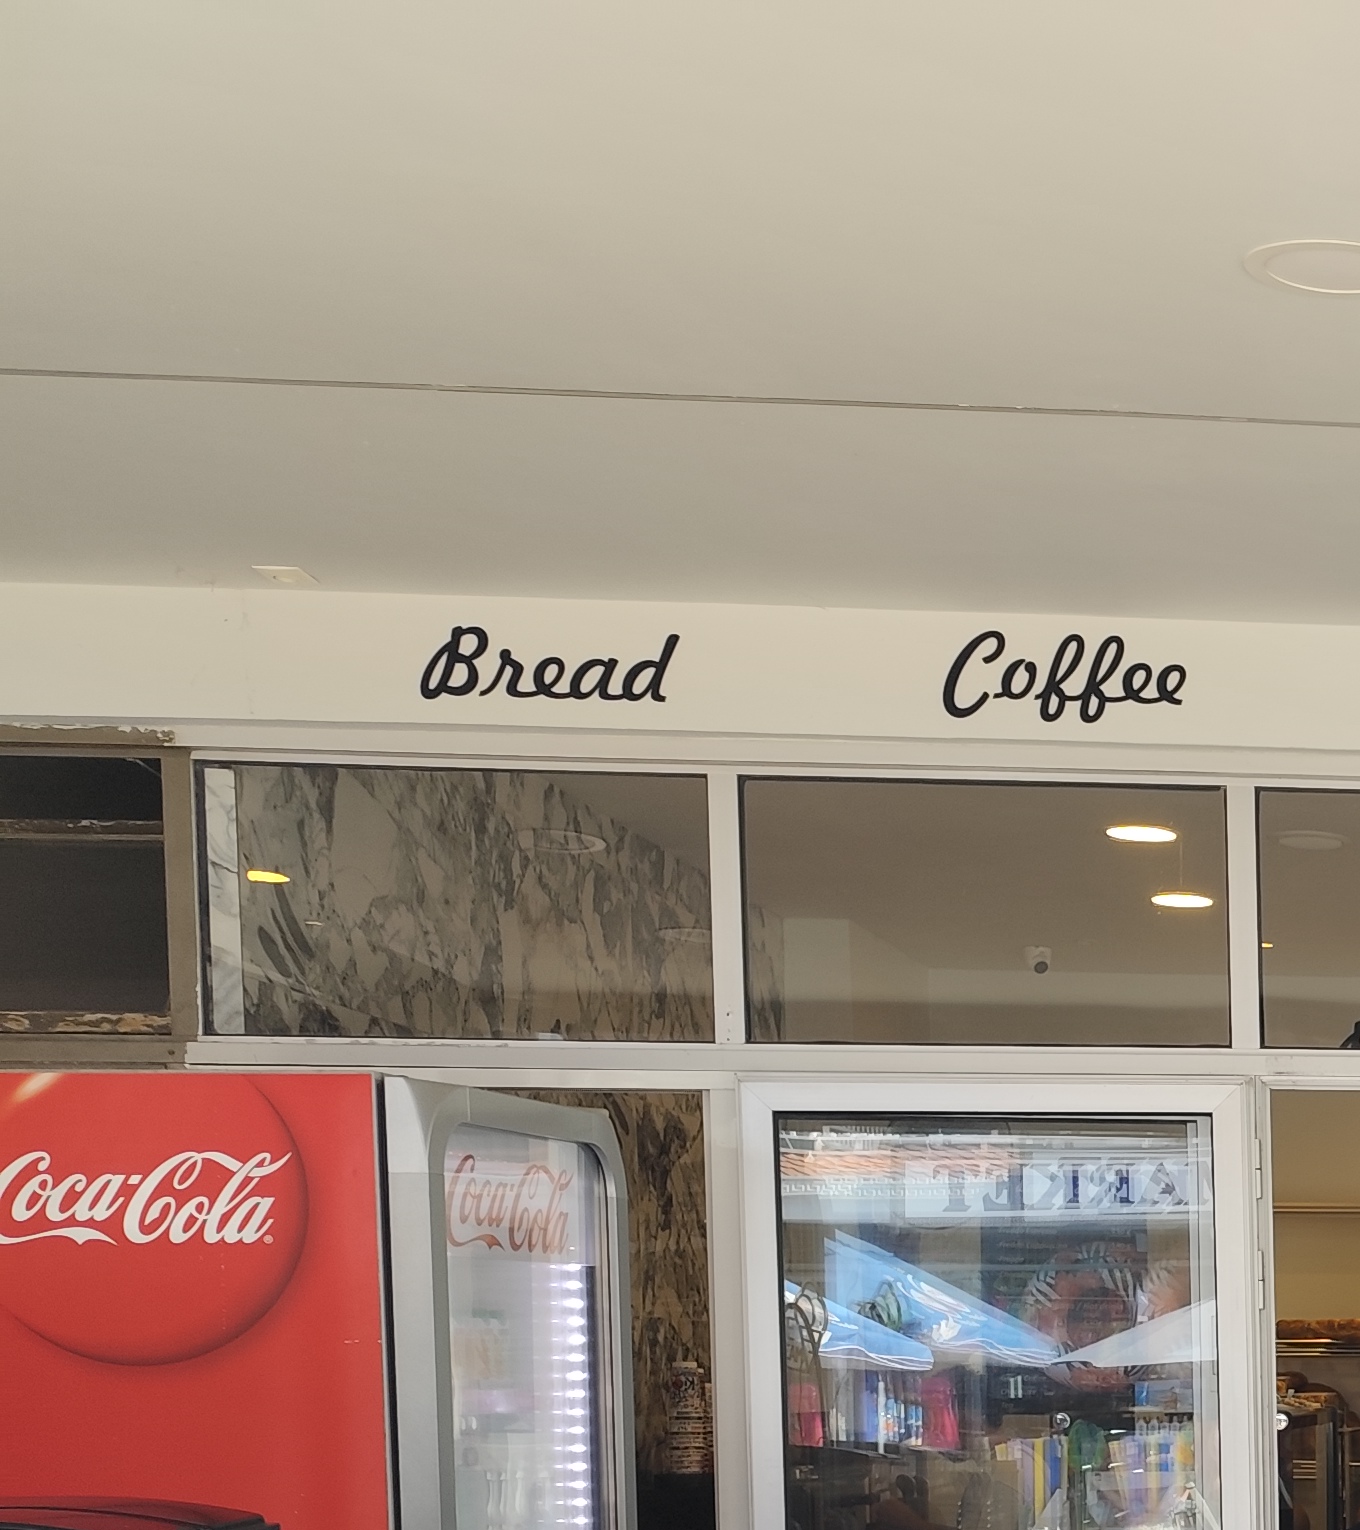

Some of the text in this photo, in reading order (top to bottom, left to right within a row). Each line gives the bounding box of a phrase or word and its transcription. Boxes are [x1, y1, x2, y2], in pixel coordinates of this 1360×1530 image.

[420, 625, 680, 704] Bread
[942, 630, 1187, 726] Coffee
[0, 1150, 292, 1245] Coca-Cola
[447, 1153, 573, 1256] Coca-Cola
